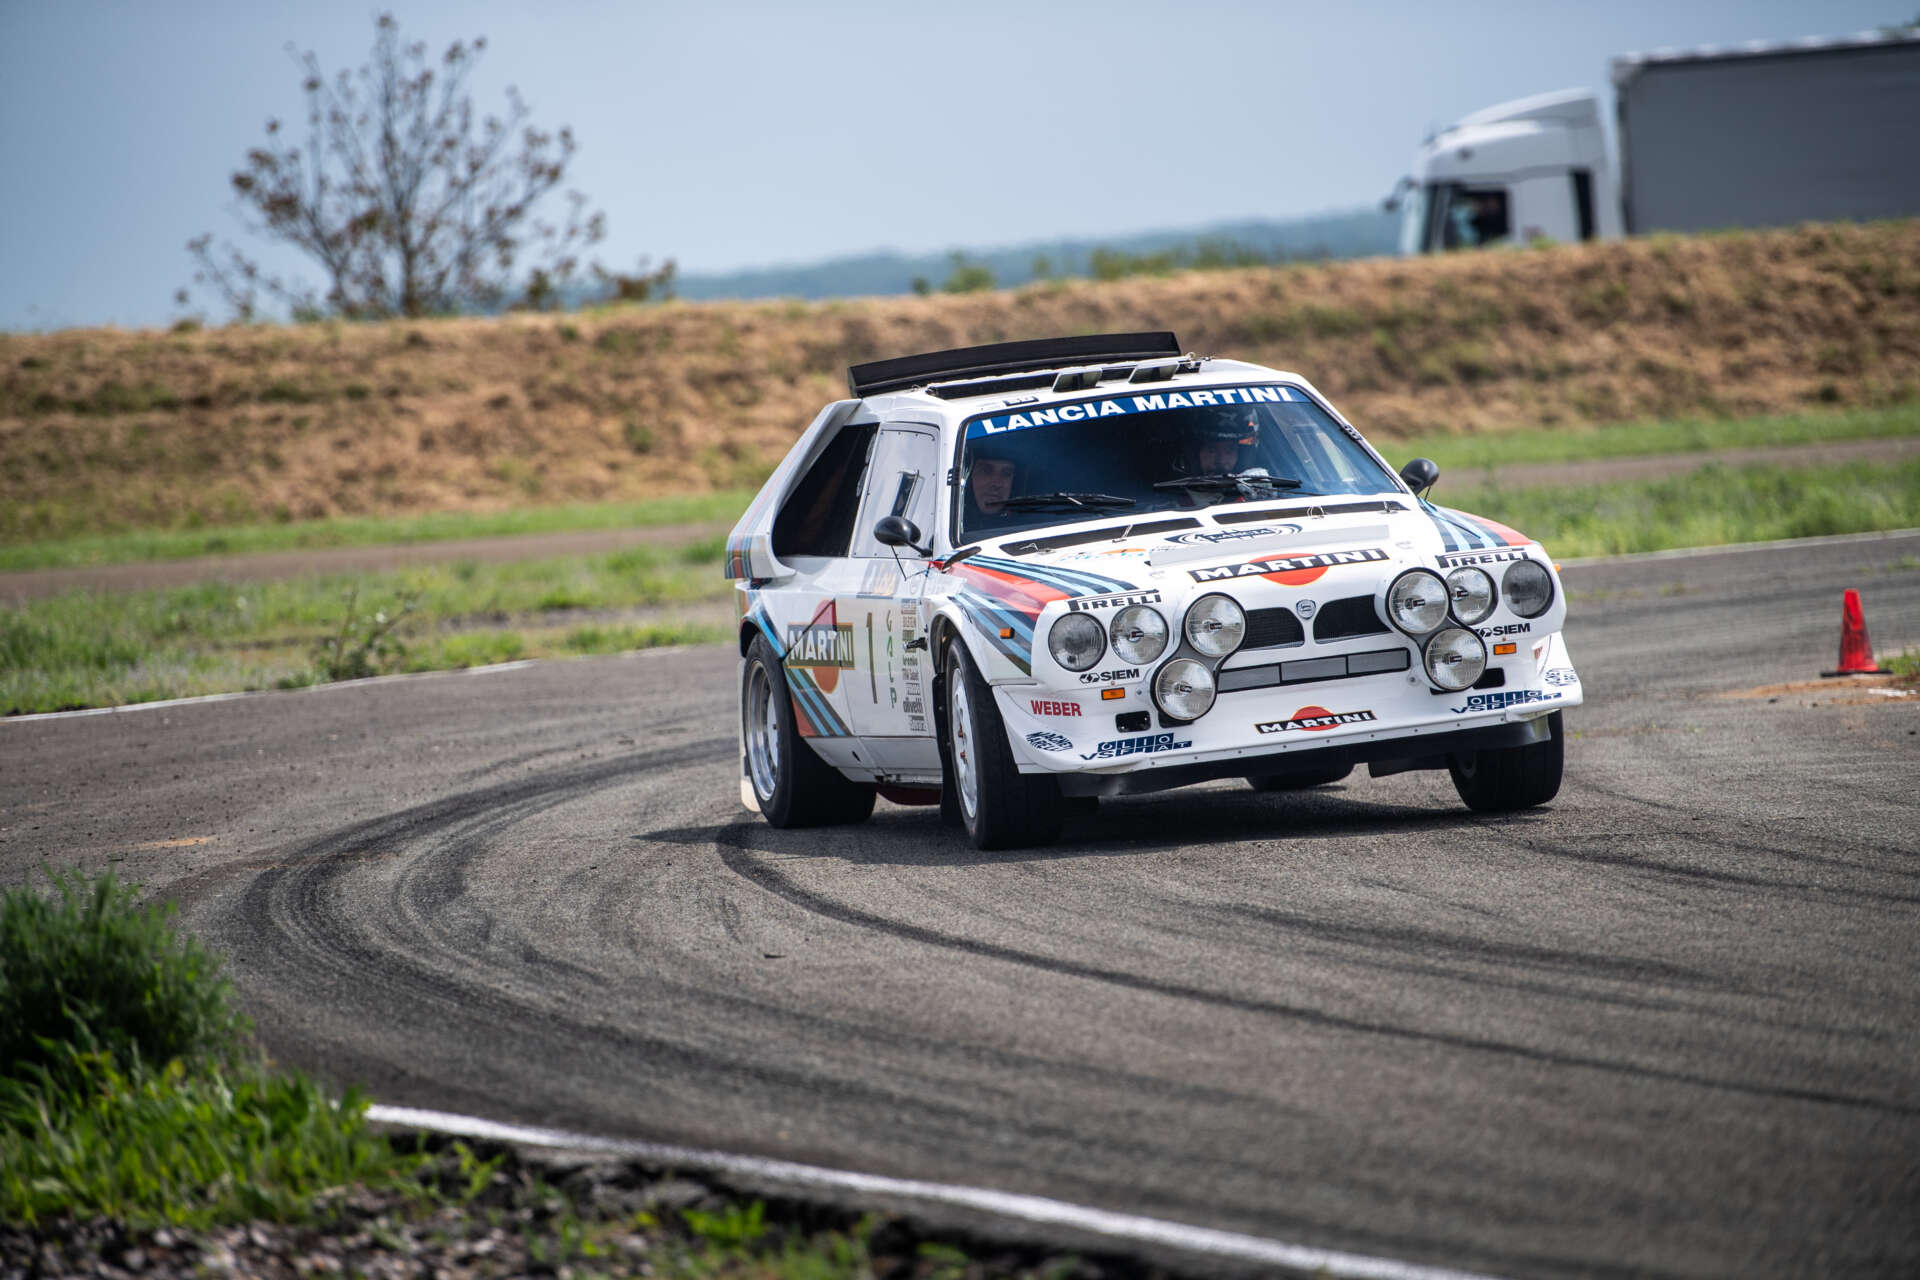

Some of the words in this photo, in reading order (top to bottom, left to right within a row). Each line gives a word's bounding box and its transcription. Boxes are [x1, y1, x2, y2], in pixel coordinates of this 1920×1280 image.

[981, 400, 1125, 434] LANCIA
[1132, 386, 1294, 412] MARTINI
[1196, 549, 1384, 581] MARTINI
[1435, 547, 1529, 569] PIRELLI
[1066, 589, 1163, 612] PIRELLI
[1492, 622, 1531, 636] SIEM
[788, 629, 854, 662] MARTINI
[1099, 668, 1140, 682] SIEM
[1030, 700, 1082, 717] WEBER
[1260, 711, 1373, 733] MARTINI
[1100, 734, 1172, 751] OLIO
